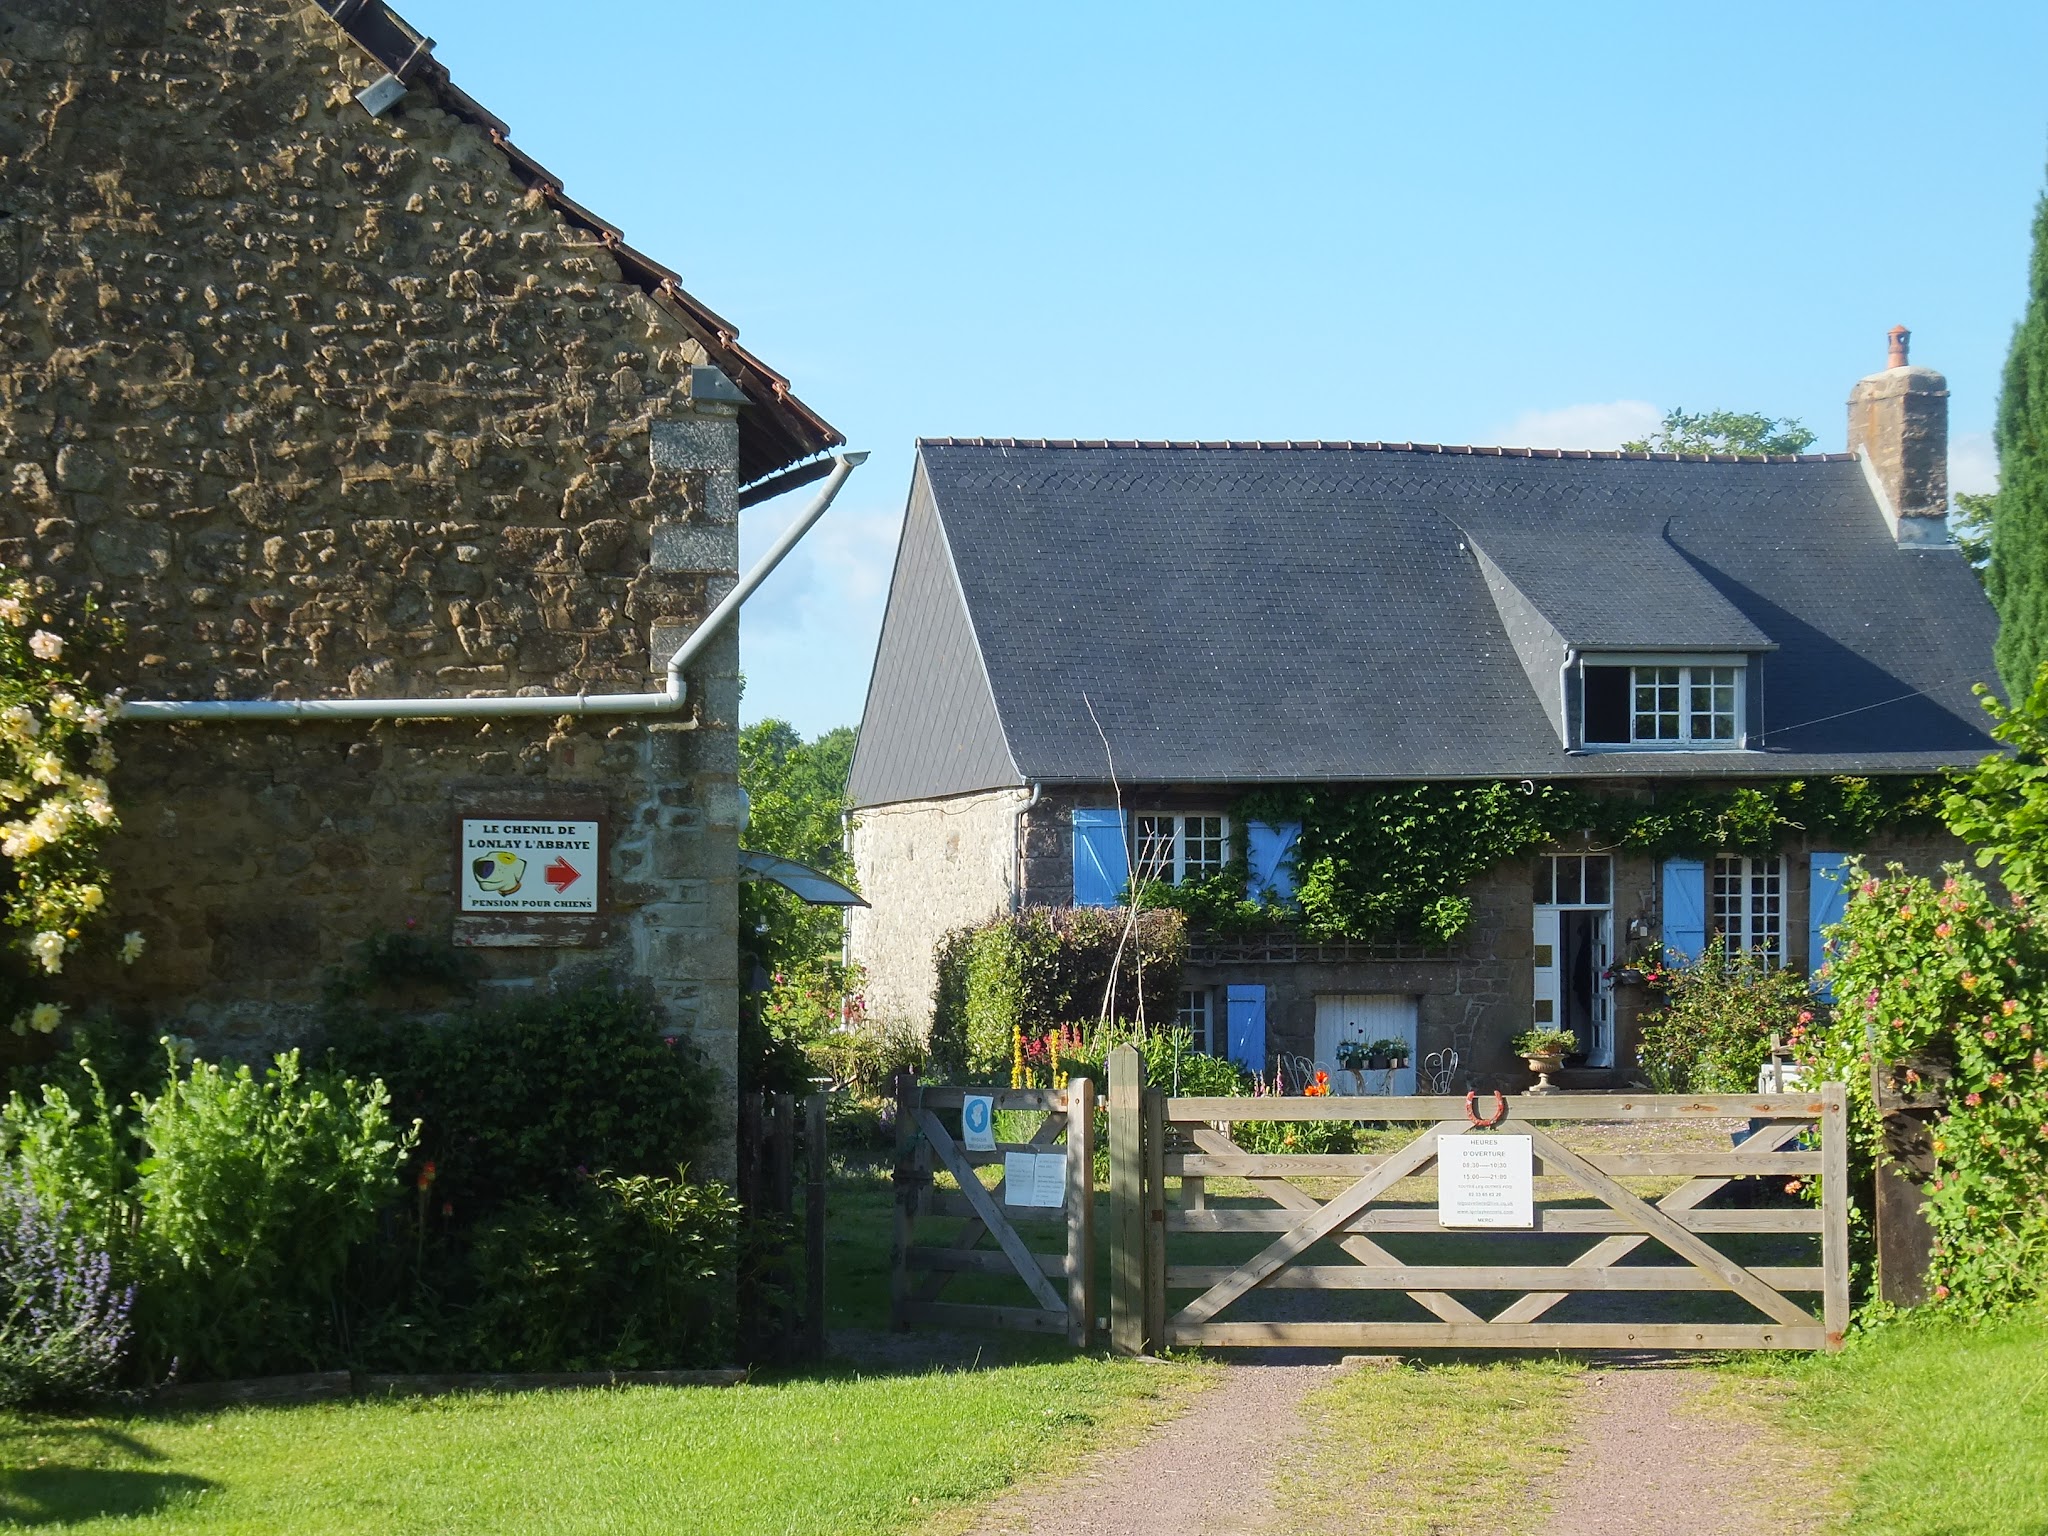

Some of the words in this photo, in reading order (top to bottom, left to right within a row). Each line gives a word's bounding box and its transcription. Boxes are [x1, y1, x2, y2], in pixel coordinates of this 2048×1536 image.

[483, 825, 499, 834] LE
[503, 825, 554, 835] CHENIL
[558, 826, 575, 835] DE
[468, 839, 522, 849] LONLAY
[525, 839, 590, 850] L'ABBAYE
[471, 899, 519, 907] PENSION
[522, 900, 551, 908] POUR
[553, 900, 592, 909] CHIENS
